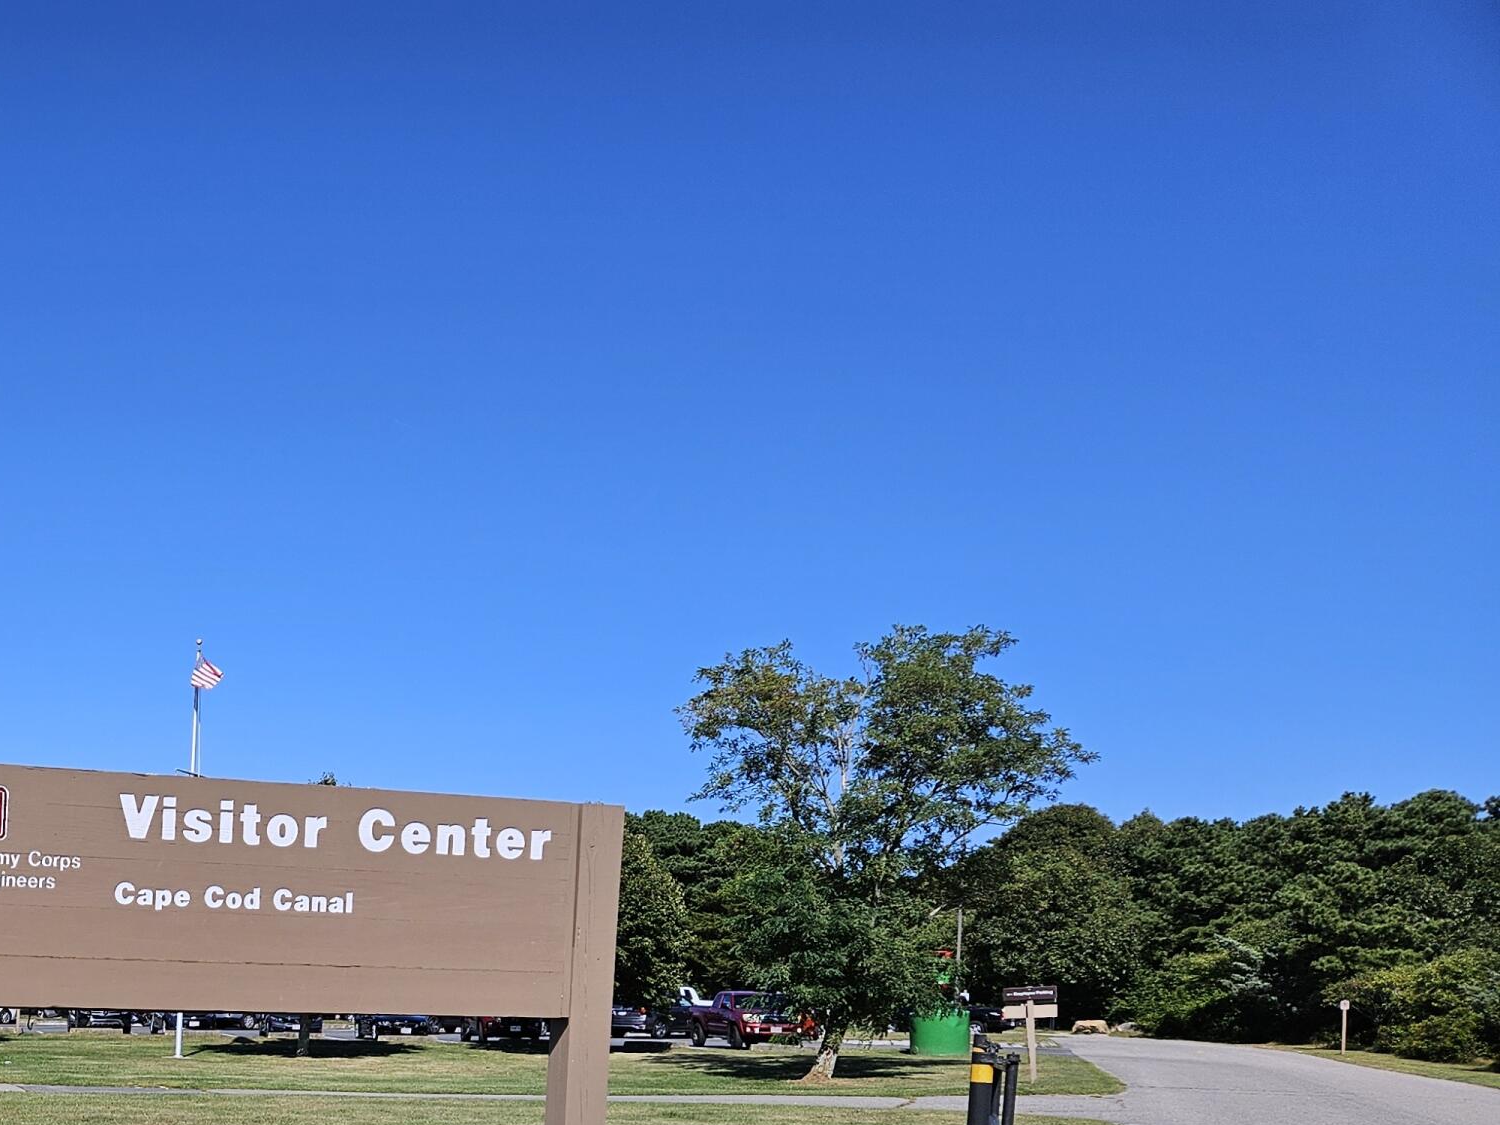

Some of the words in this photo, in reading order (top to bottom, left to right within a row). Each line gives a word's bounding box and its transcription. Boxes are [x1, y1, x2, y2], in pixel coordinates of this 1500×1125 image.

[119, 793, 328, 849] Visitor
[358, 808, 553, 861] Center
[28, 851, 81, 871] Corps
[114, 882, 191, 911] Cape
[203, 886, 261, 910] Cod
[272, 889, 354, 914] Canal
